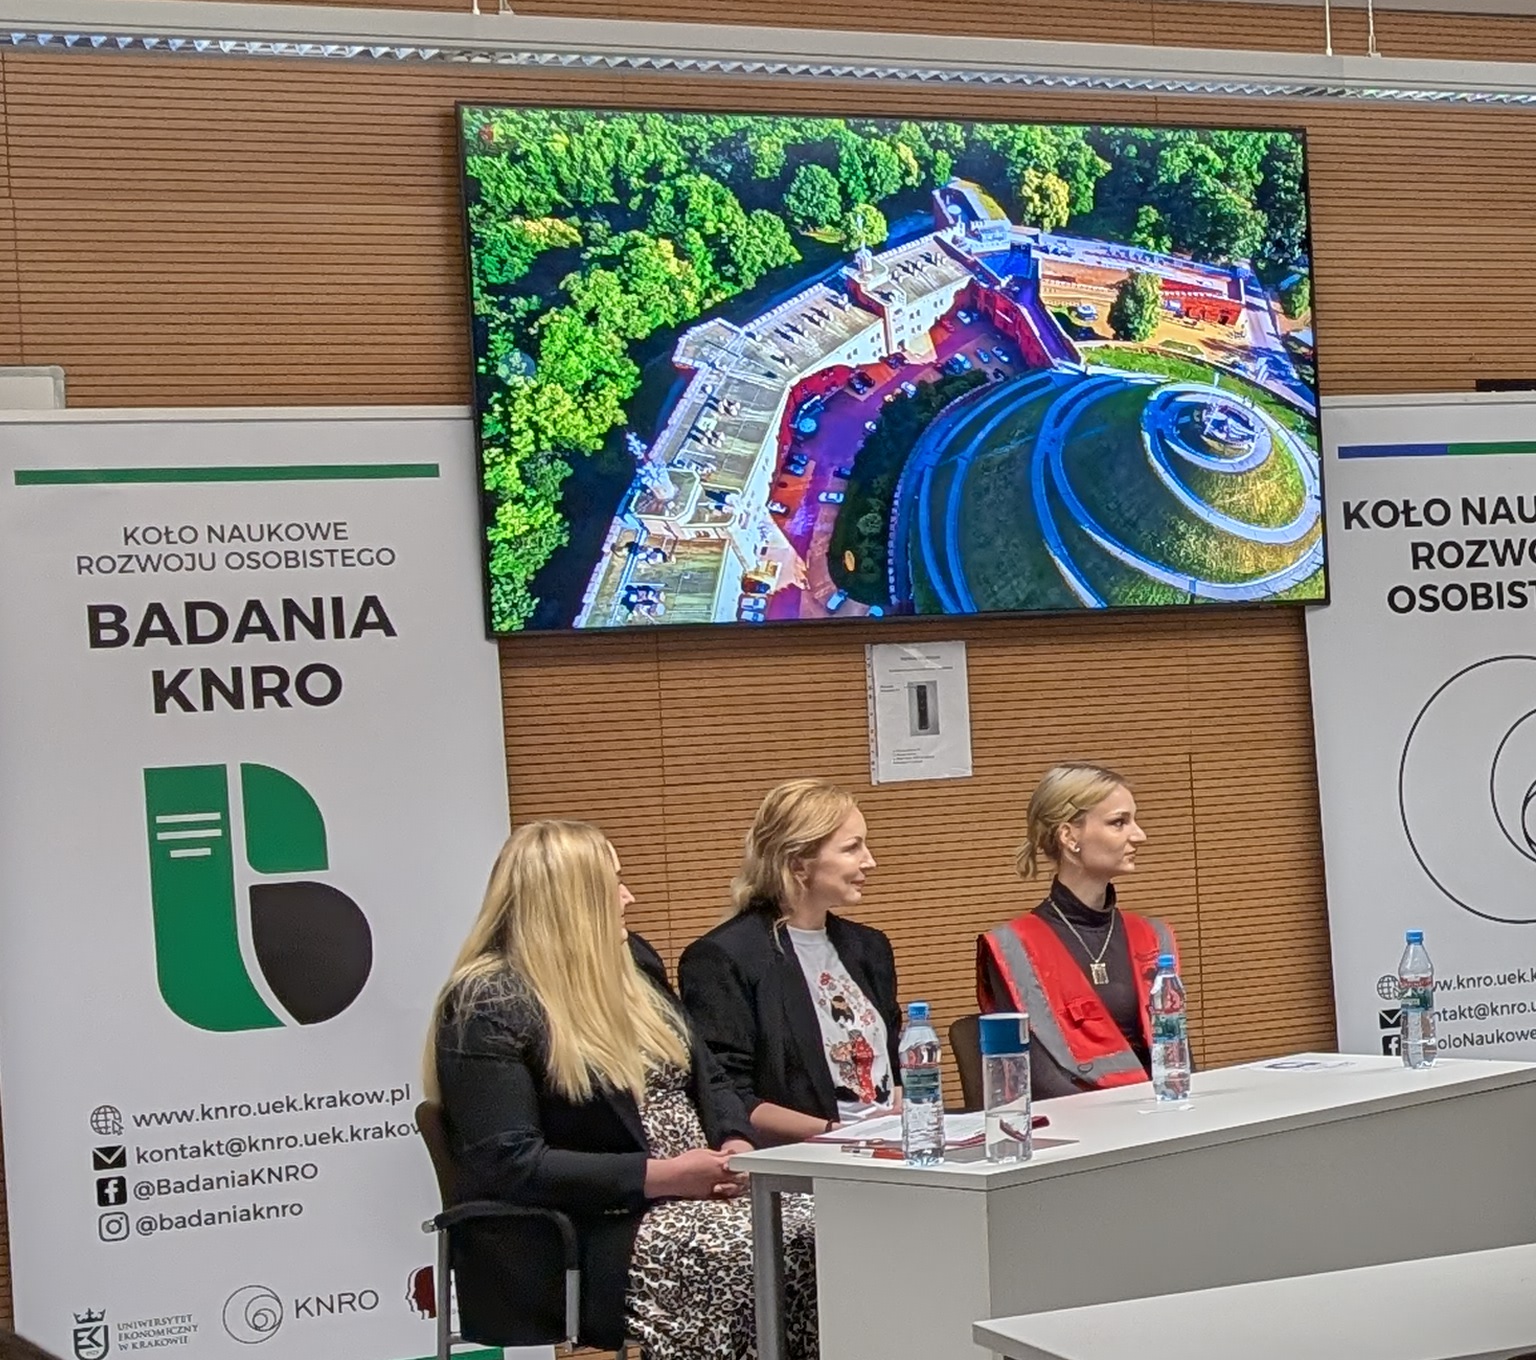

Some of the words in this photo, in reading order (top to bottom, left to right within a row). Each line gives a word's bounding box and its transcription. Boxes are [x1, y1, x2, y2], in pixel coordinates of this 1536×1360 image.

[1342, 497, 1452, 530] KOŁO
[122, 525, 199, 546] KOŁO
[206, 521, 349, 544] NAUKOWE
[76, 551, 217, 575] ROZWOJU
[224, 547, 396, 571] OSOBISTEGO
[87, 595, 398, 649] BADANIA
[151, 663, 343, 714] KNRO
[132, 1083, 411, 1128] www.knro.uek.krakow.pl
[133, 1162, 319, 1201] @BadaniaKNRO
[135, 1201, 304, 1236] @badaniaknro
[294, 1289, 380, 1319] KNRO
